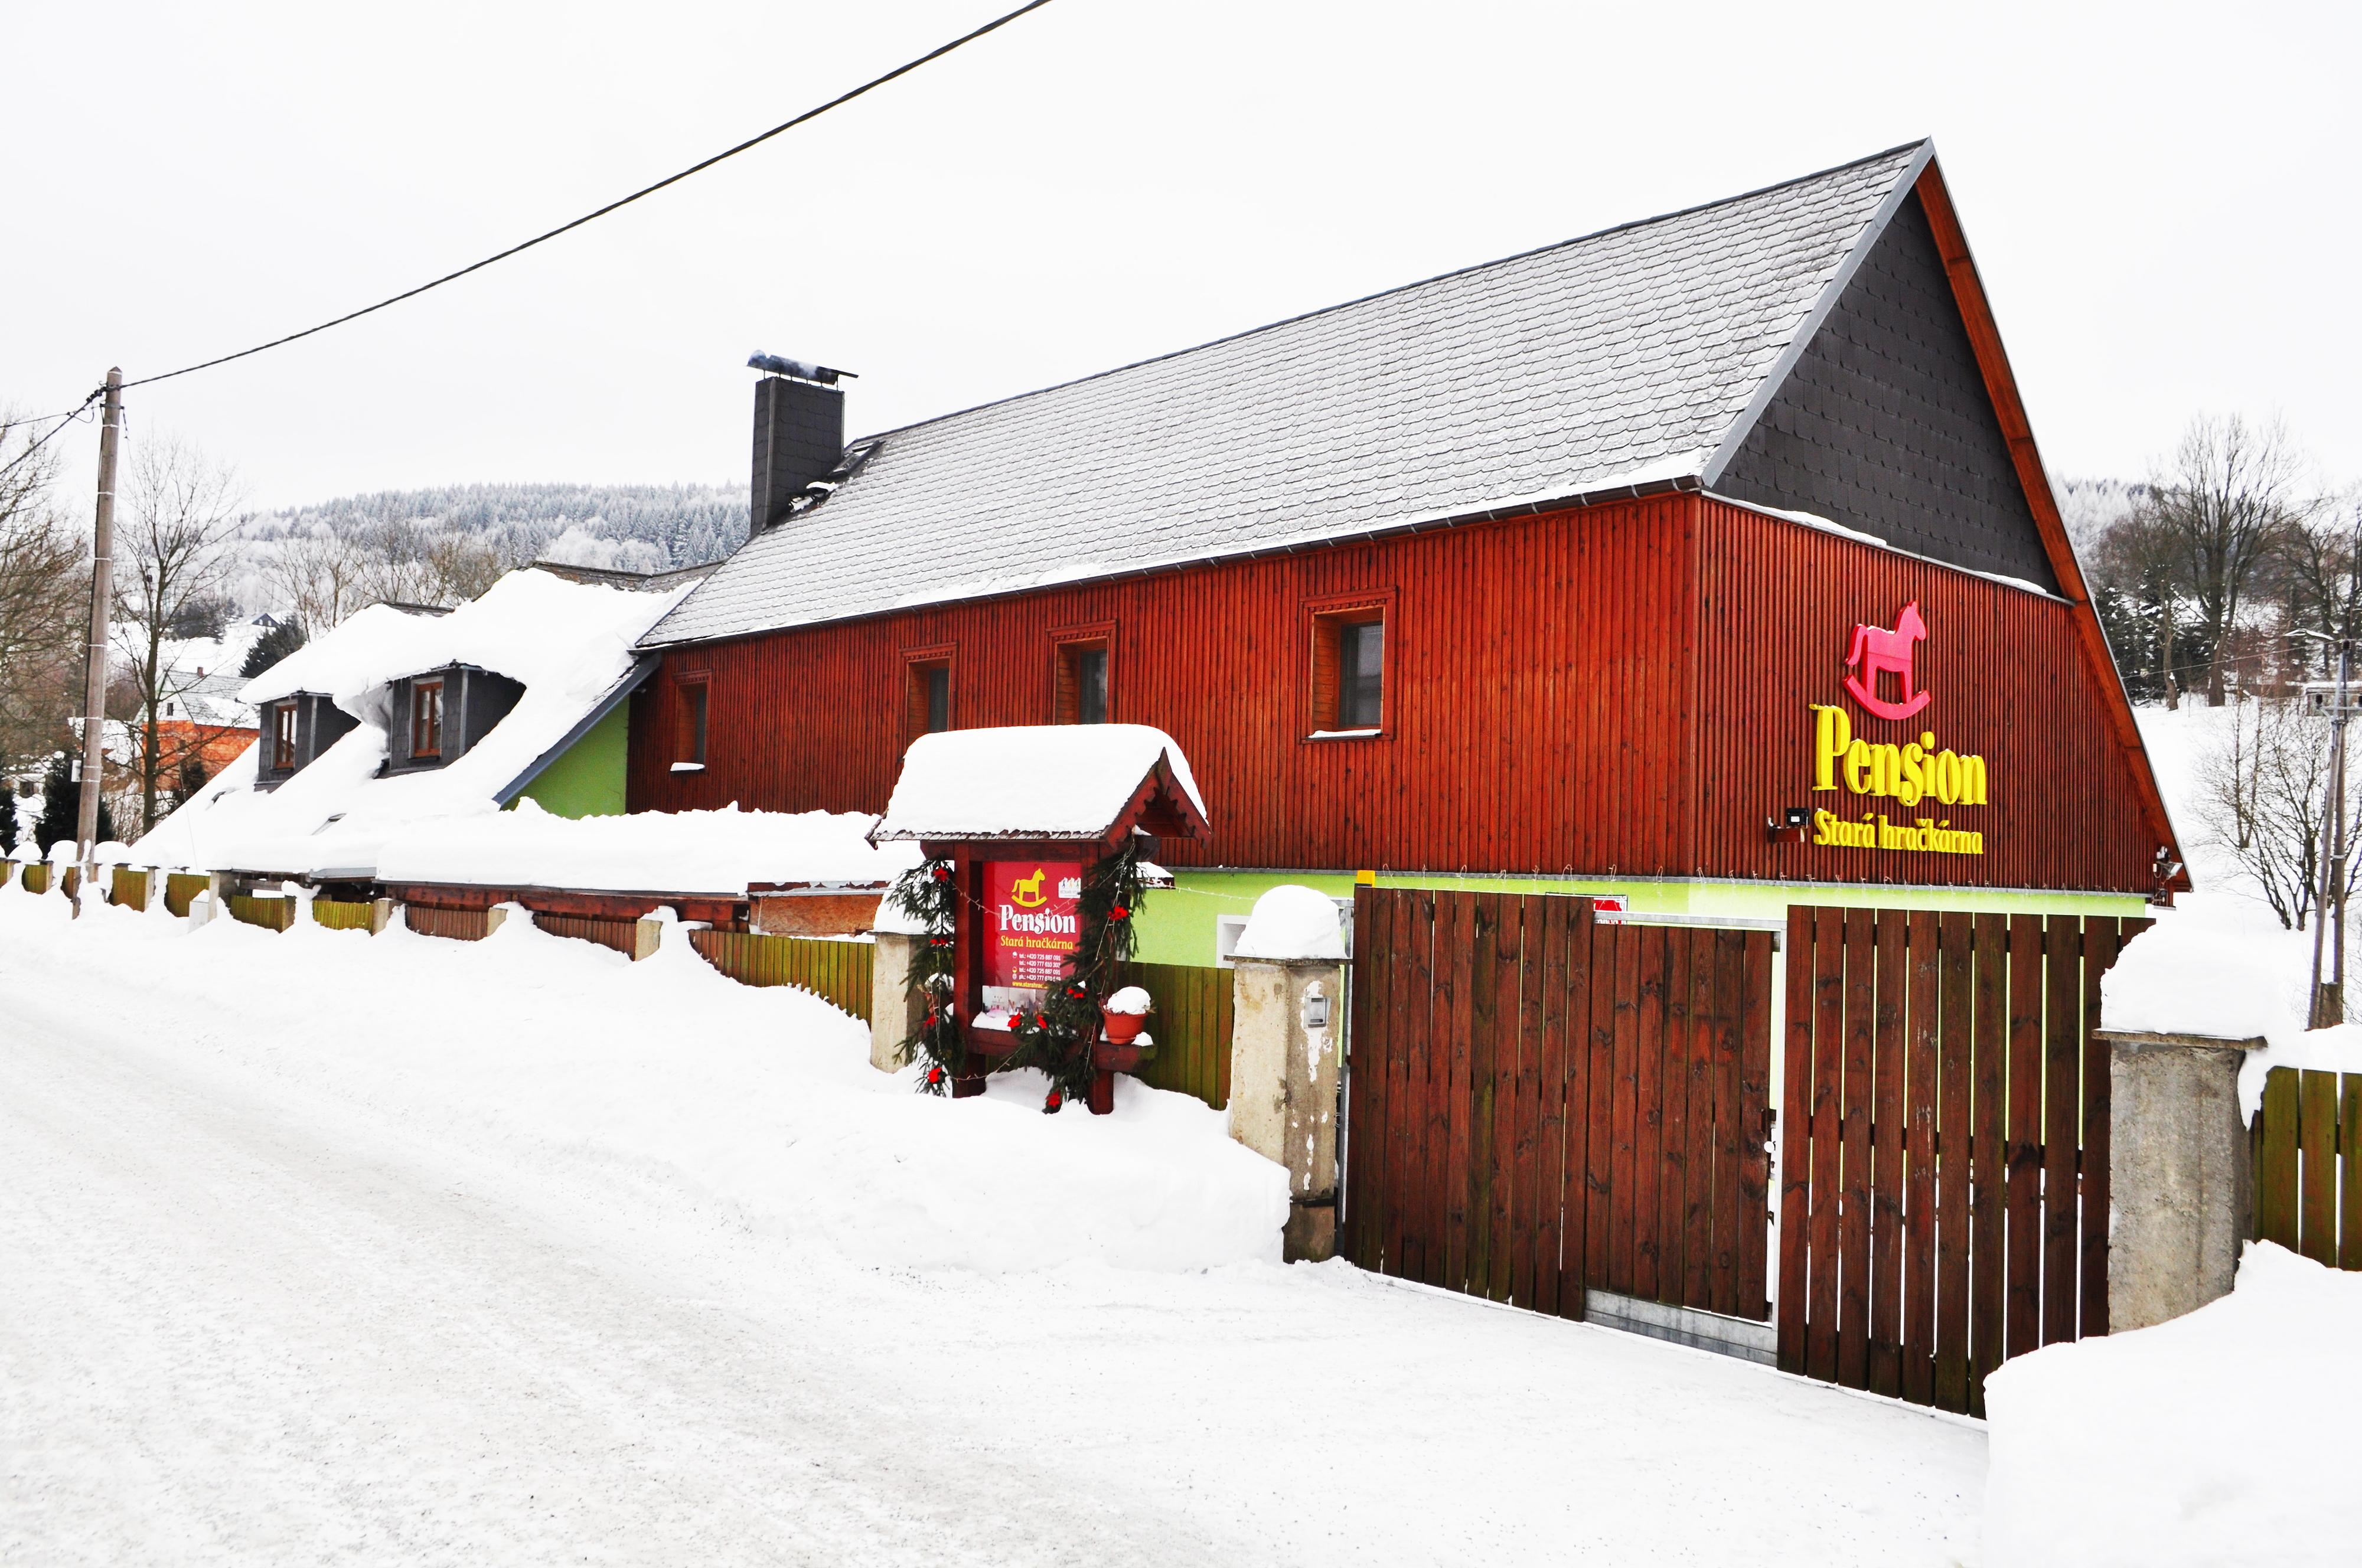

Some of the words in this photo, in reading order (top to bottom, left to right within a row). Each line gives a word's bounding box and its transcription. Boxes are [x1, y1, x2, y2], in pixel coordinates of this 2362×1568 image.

[1809, 704, 1987, 806] Pension
[1813, 808, 1875, 848] Stará
[1878, 815, 1983, 854] hračkárna
[999, 904, 1076, 935] Pension
[1000, 935, 1023, 947] Stará
[1026, 936, 1074, 950] hračkárna
